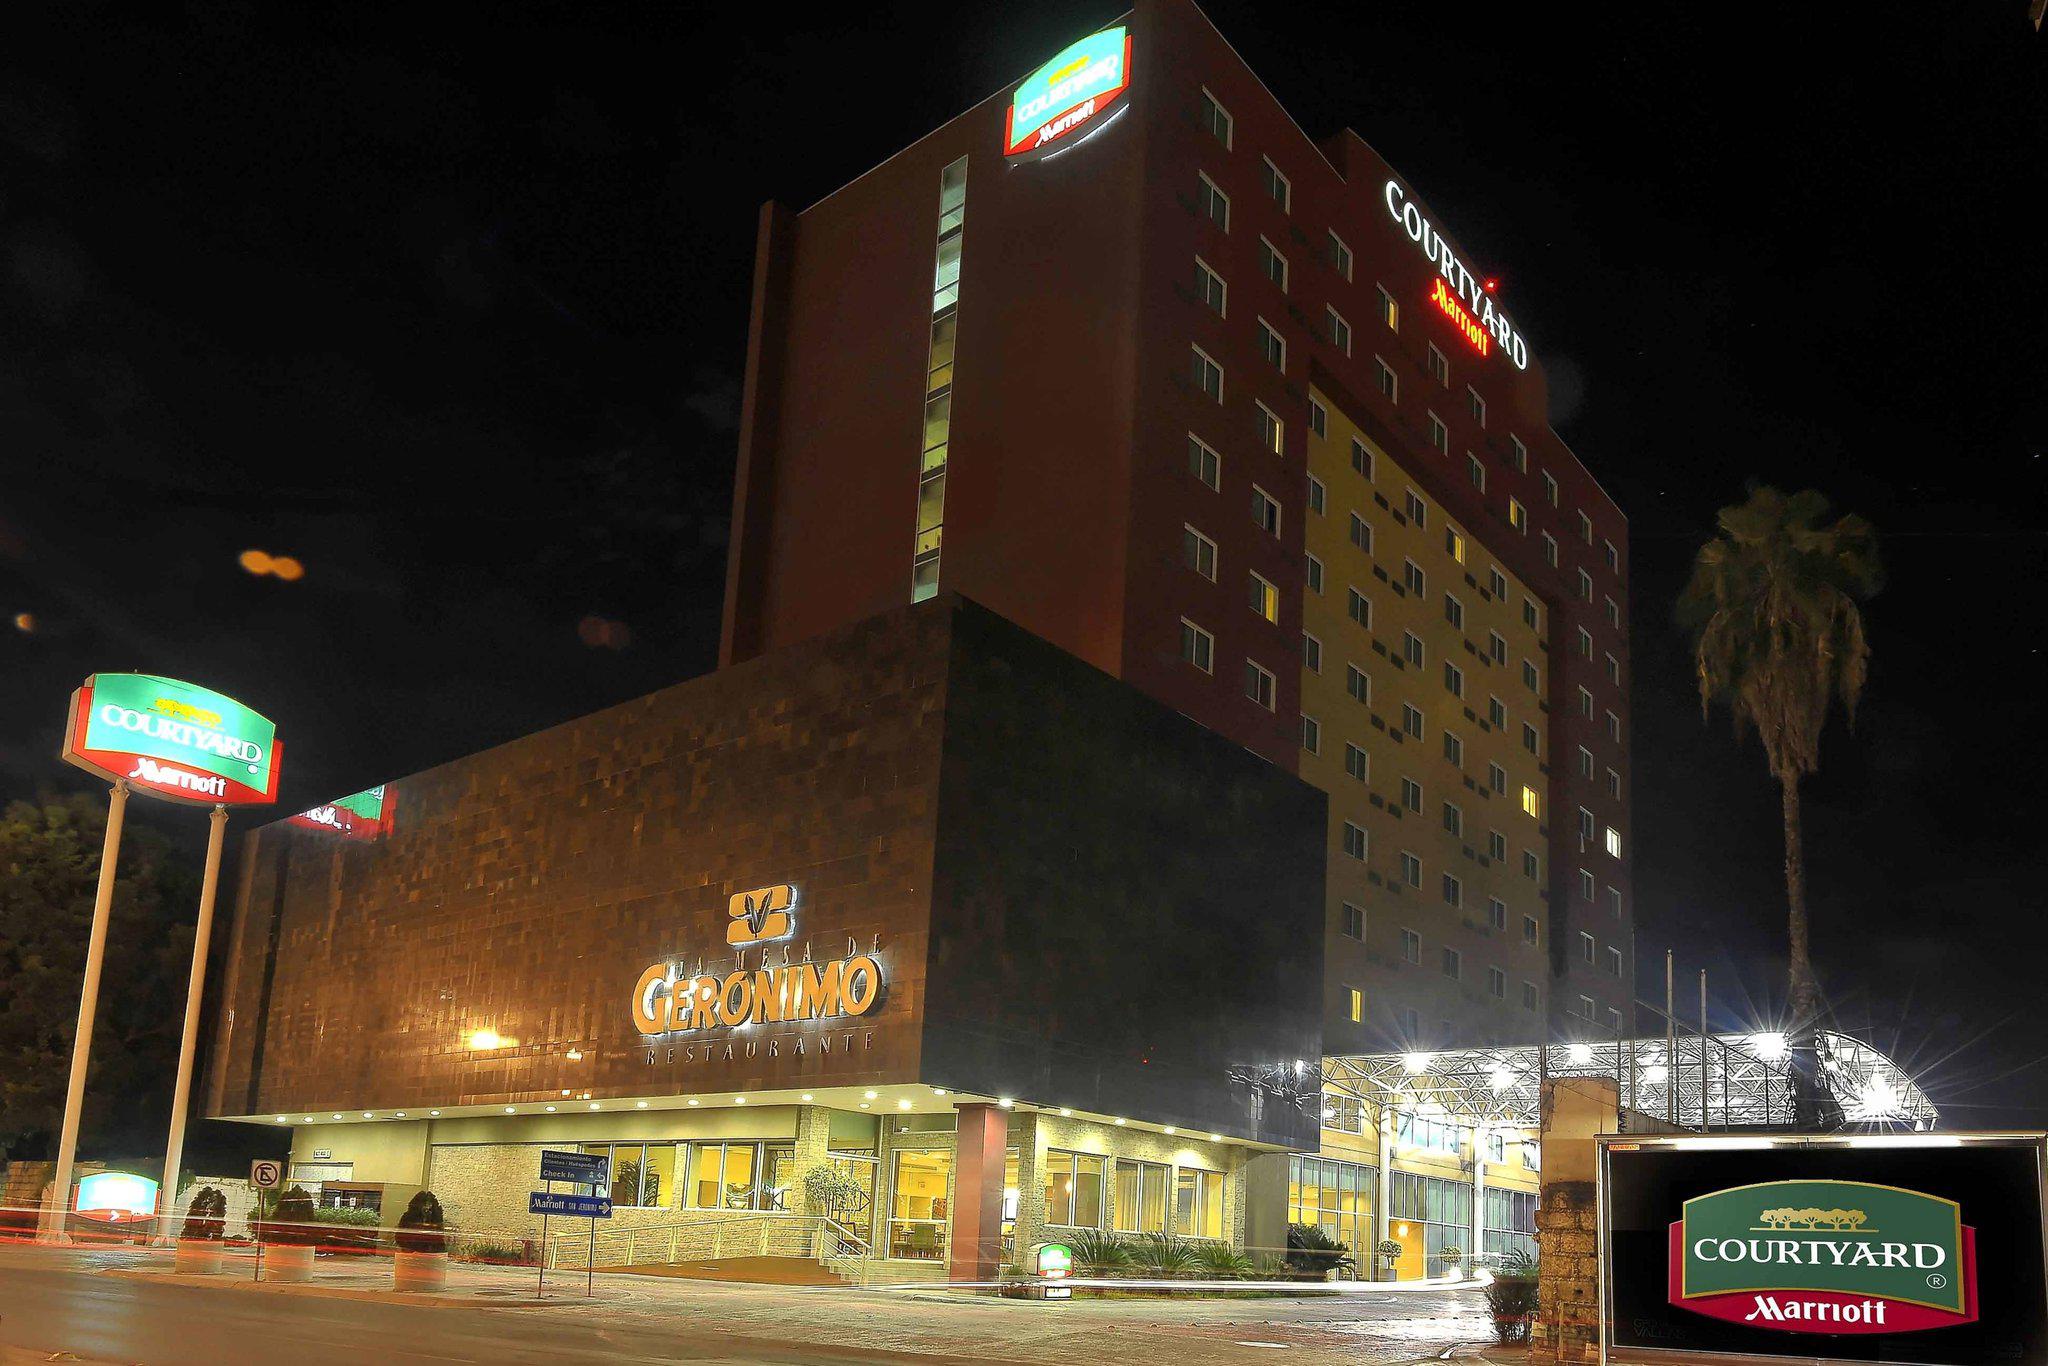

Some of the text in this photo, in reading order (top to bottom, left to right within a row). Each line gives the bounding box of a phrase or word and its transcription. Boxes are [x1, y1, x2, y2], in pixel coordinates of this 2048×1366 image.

[1385, 180, 1528, 370] COURTYARD
[1432, 277, 1488, 356] Marriott
[101, 704, 263, 763] COURTYARD
[128, 757, 227, 797] Marriott
[735, 940, 812, 971] MESA
[847, 933, 882, 958] DE
[646, 1032, 874, 1065] RESTAURANTE
[543, 1169, 575, 1179] Check In
[532, 1197, 564, 1210] Marriott
[1694, 1237, 1946, 1269] COURTYARD
[1745, 1294, 1887, 1325] Marriott
